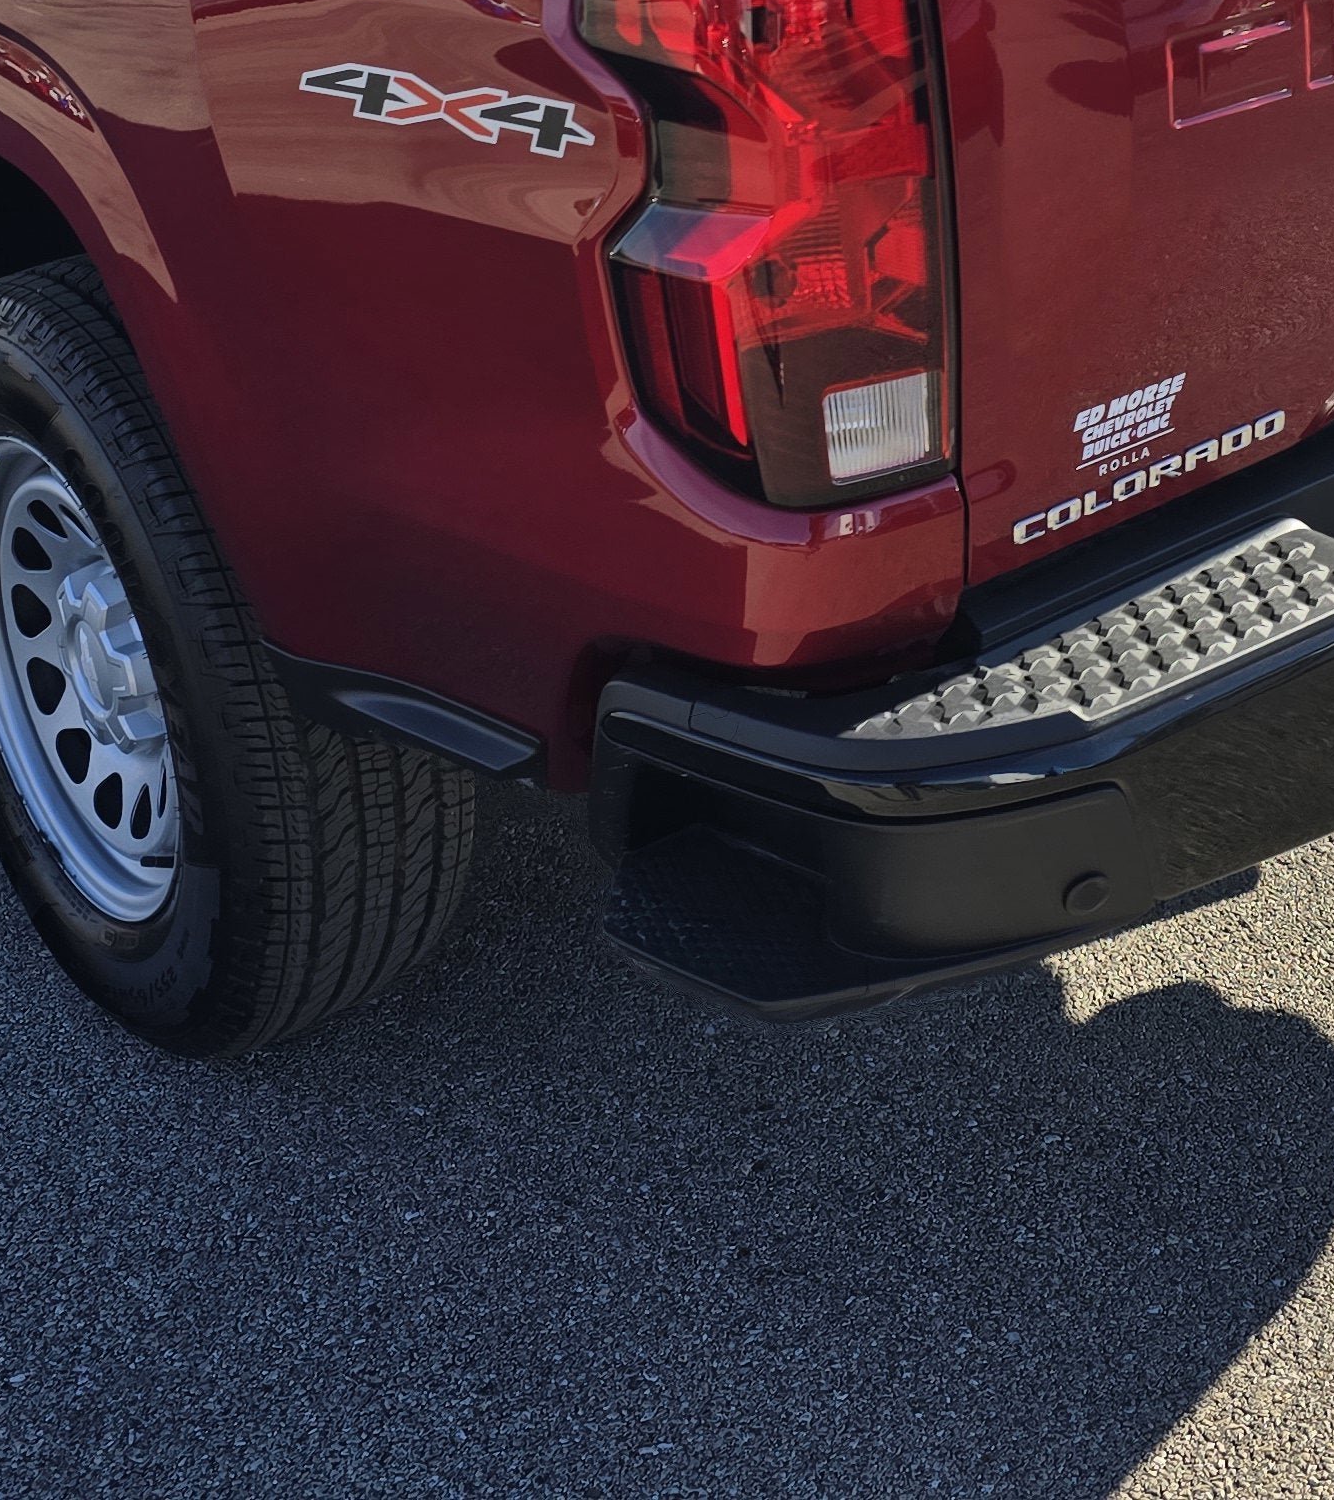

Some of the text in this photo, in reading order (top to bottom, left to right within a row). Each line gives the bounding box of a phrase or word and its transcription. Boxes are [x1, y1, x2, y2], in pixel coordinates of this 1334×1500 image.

[1073, 372, 1187, 433] ED MORSE
[1082, 395, 1177, 444] CHEVROLET
[1013, 409, 1286, 545] COLORADO
[1098, 446, 1151, 477] ROLLA
